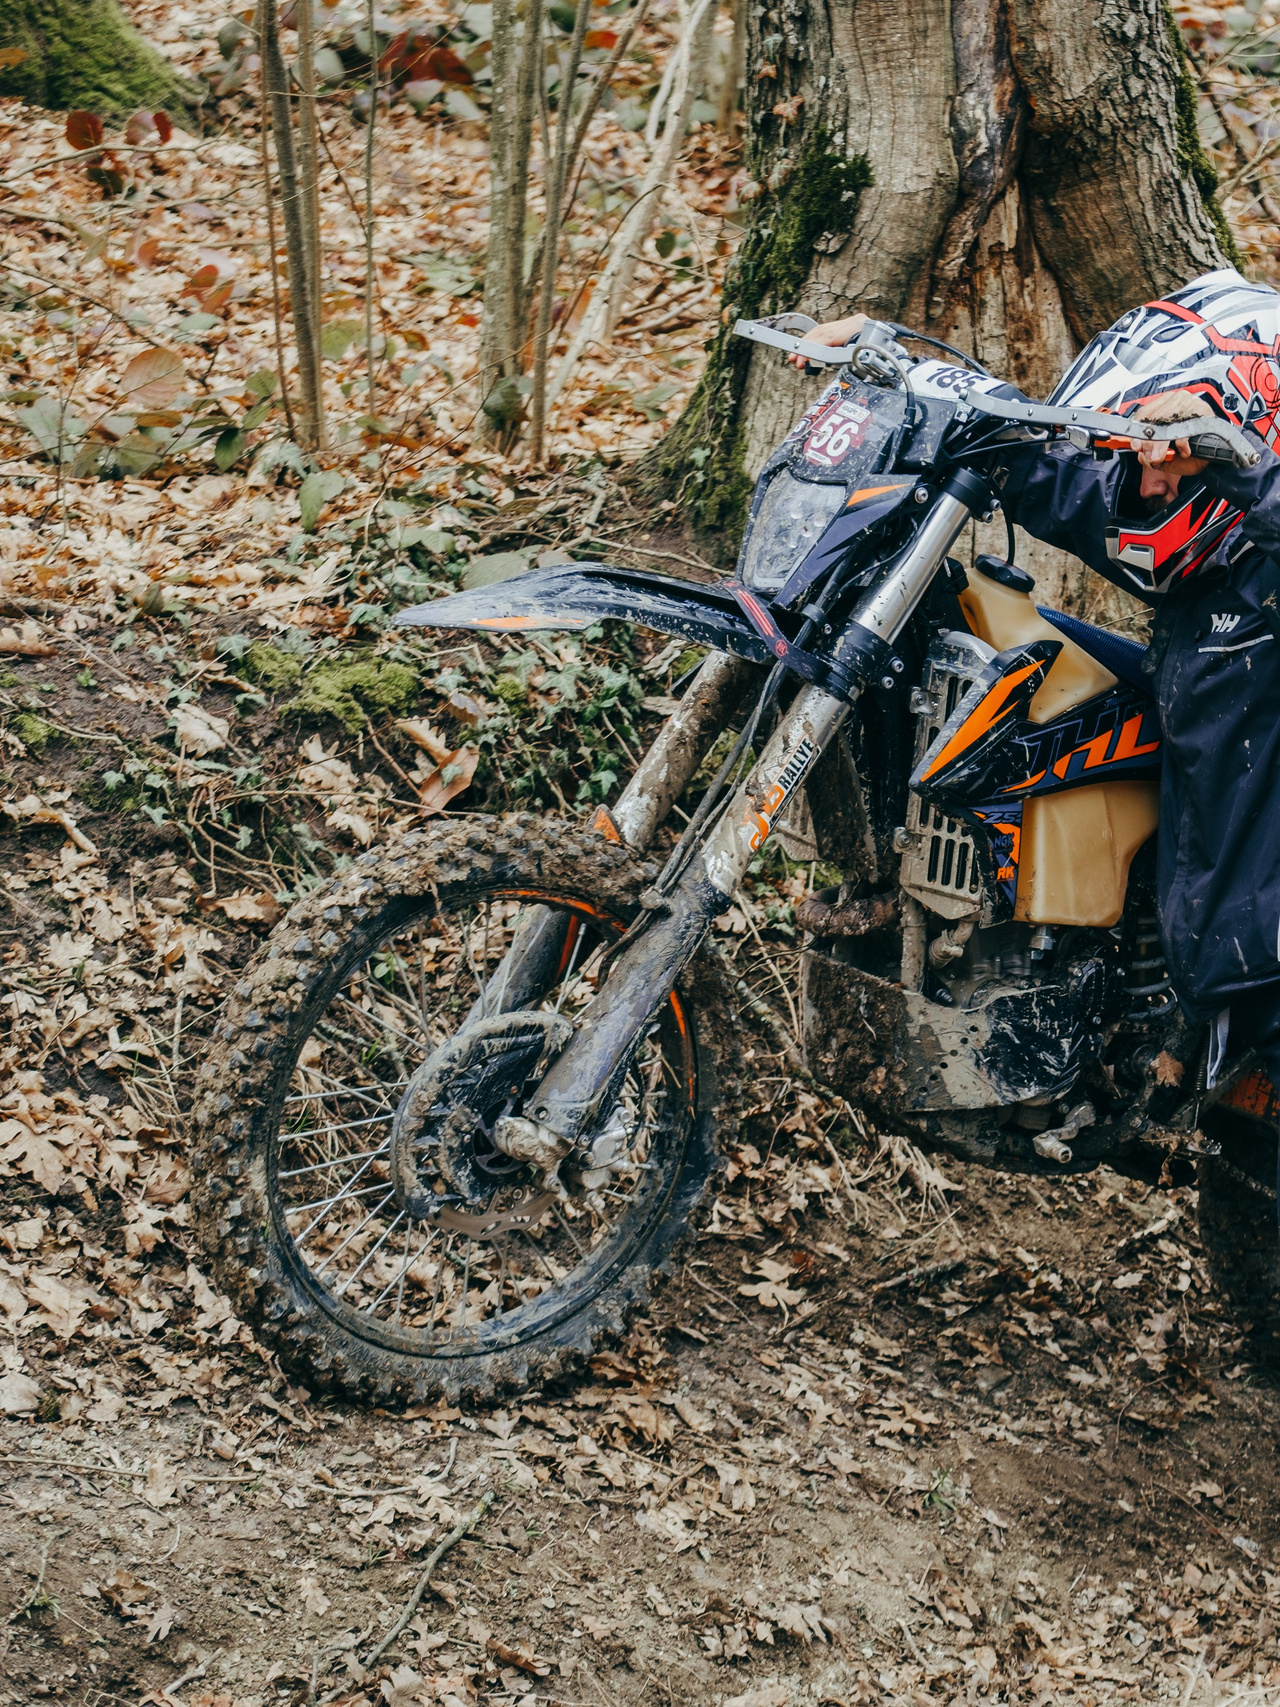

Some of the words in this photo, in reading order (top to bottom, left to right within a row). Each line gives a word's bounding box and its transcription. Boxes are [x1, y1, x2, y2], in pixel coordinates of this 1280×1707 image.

[926, 367, 988, 393] 185
[810, 414, 859, 457] 56
[777, 737, 815, 791] RALLYE
[994, 832, 1015, 849] NGK
